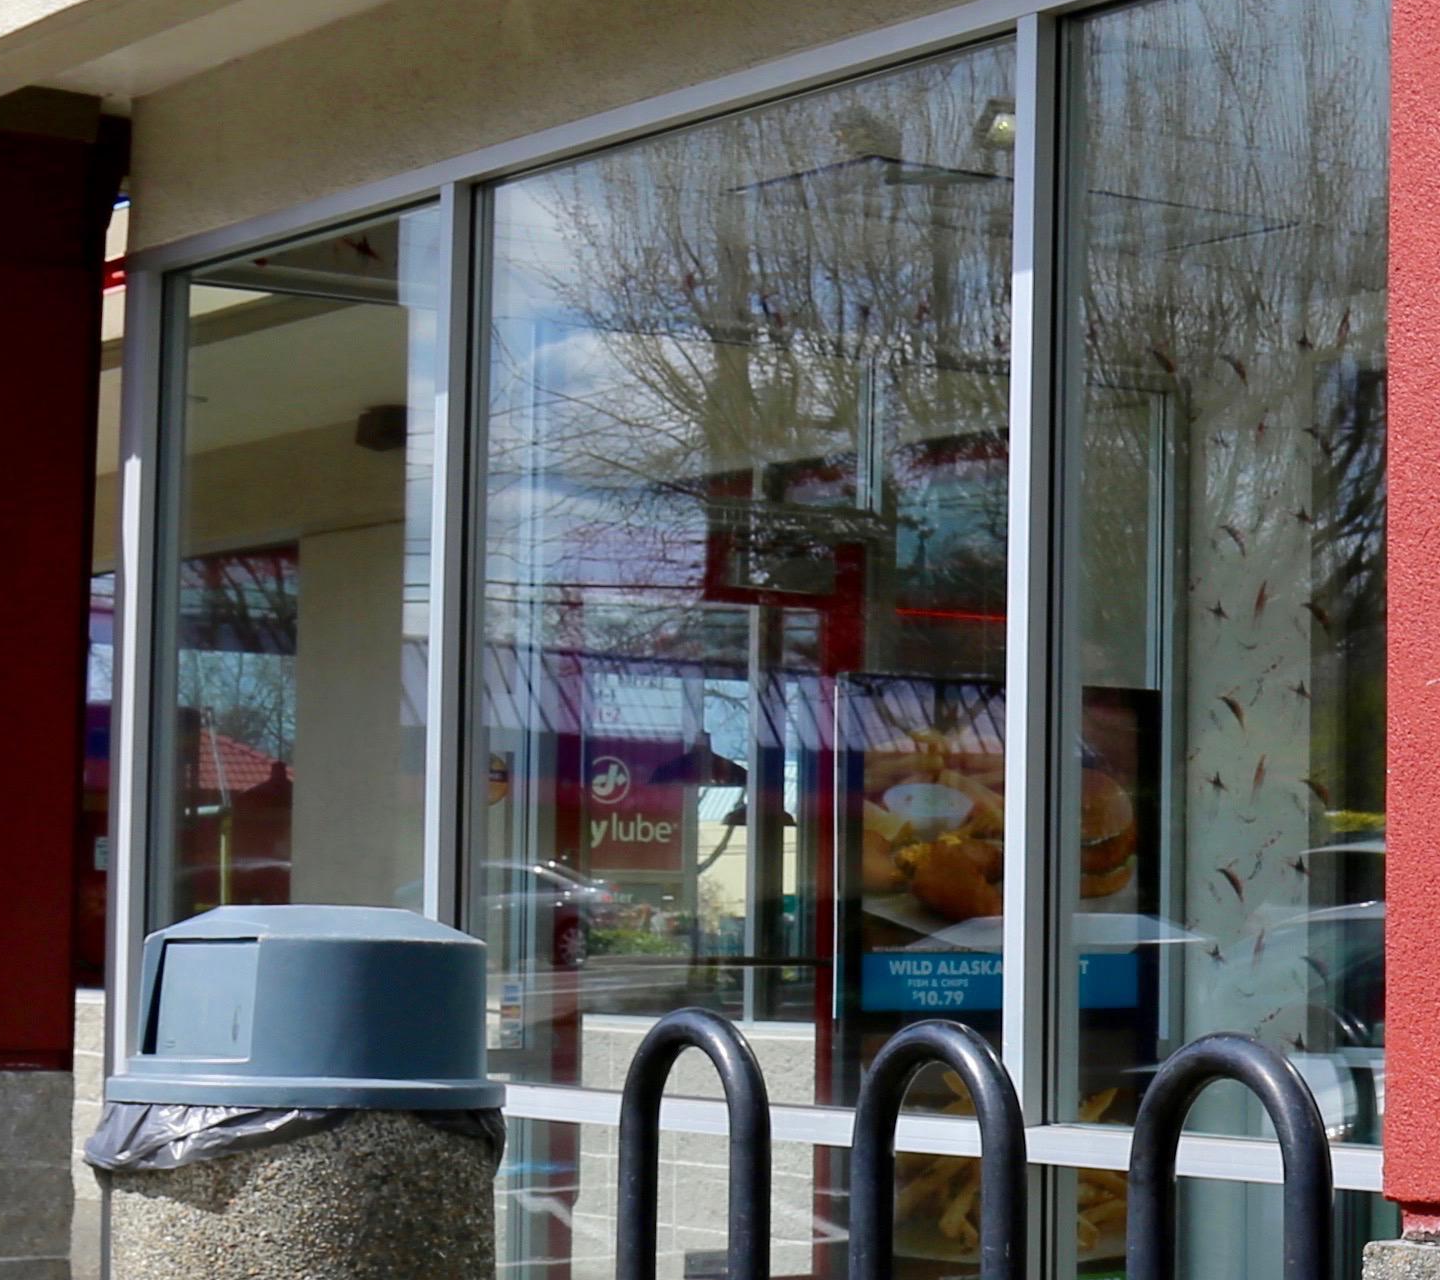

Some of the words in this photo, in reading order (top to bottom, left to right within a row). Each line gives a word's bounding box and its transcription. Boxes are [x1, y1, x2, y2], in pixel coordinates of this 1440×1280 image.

[612, 812, 673, 843] lube
[889, 960, 932, 976] WILD
[907, 979, 930, 988] FISH
[940, 978, 969, 988] CHIPS
[912, 990, 964, 1006] $10.79
